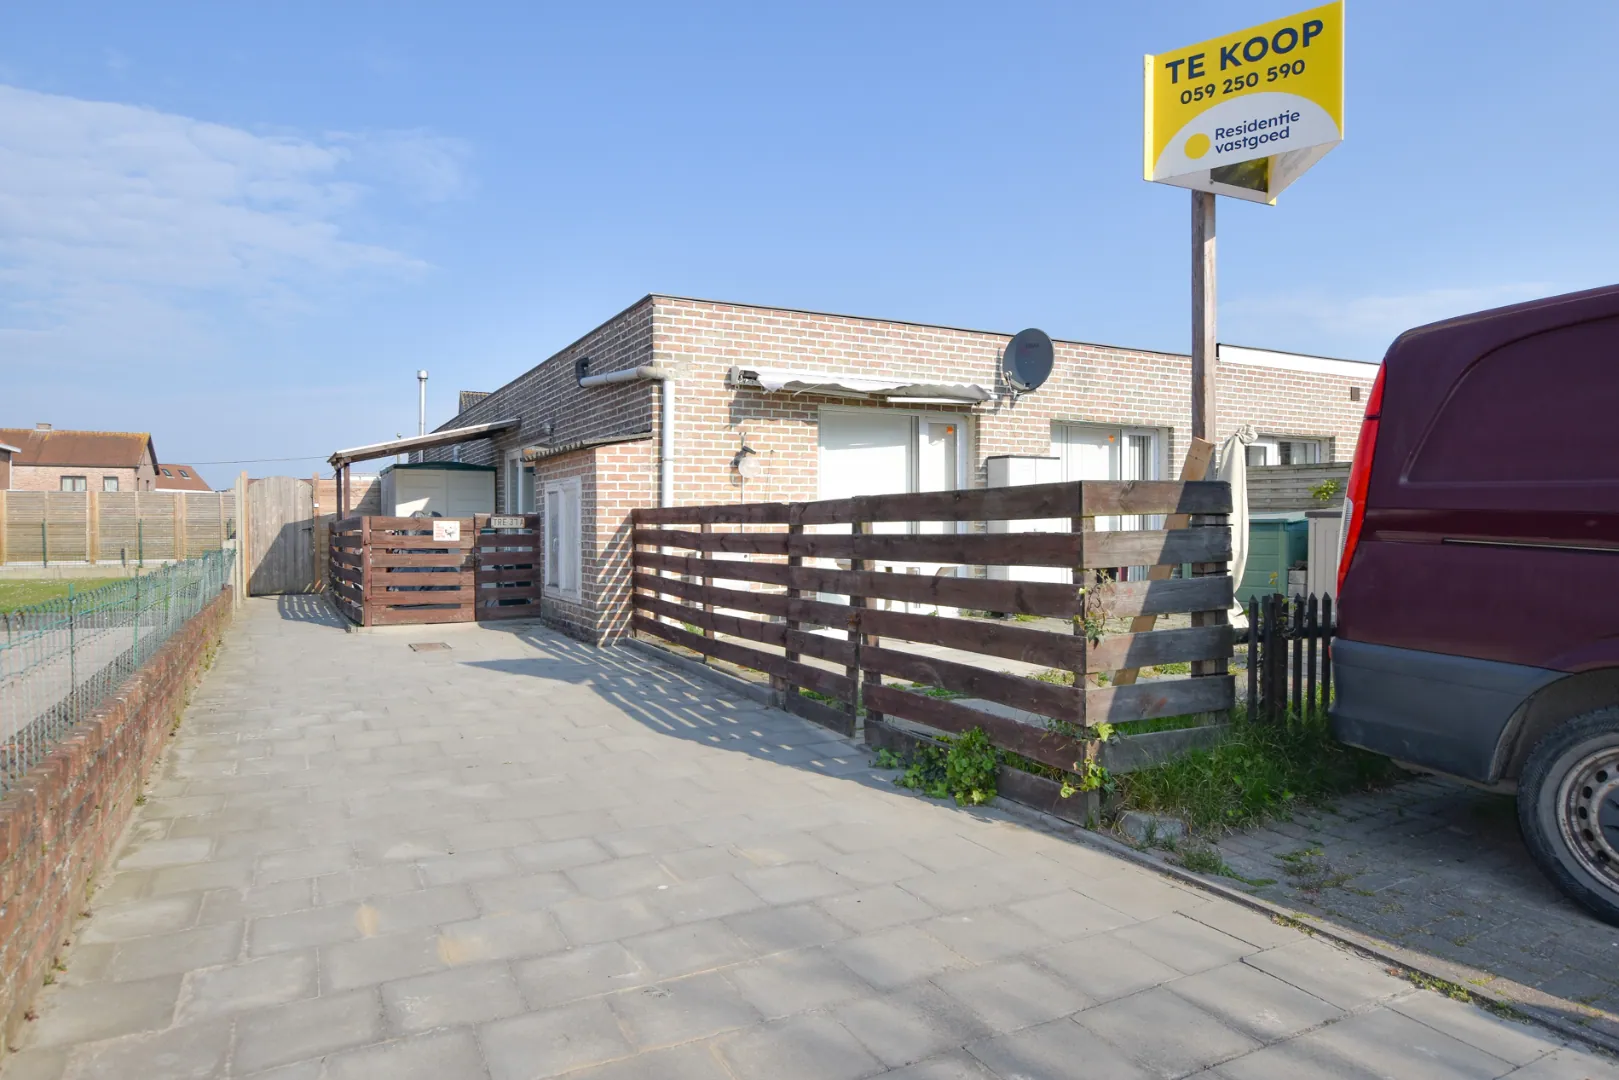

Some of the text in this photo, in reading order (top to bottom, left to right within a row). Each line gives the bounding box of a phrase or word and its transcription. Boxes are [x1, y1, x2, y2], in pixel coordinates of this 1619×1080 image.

[1165, 19, 1324, 84] TE KOOP
[1180, 59, 1305, 105] 059 250 590
[1215, 110, 1301, 140] Residentie
[1215, 126, 1290, 154] vastgoed
